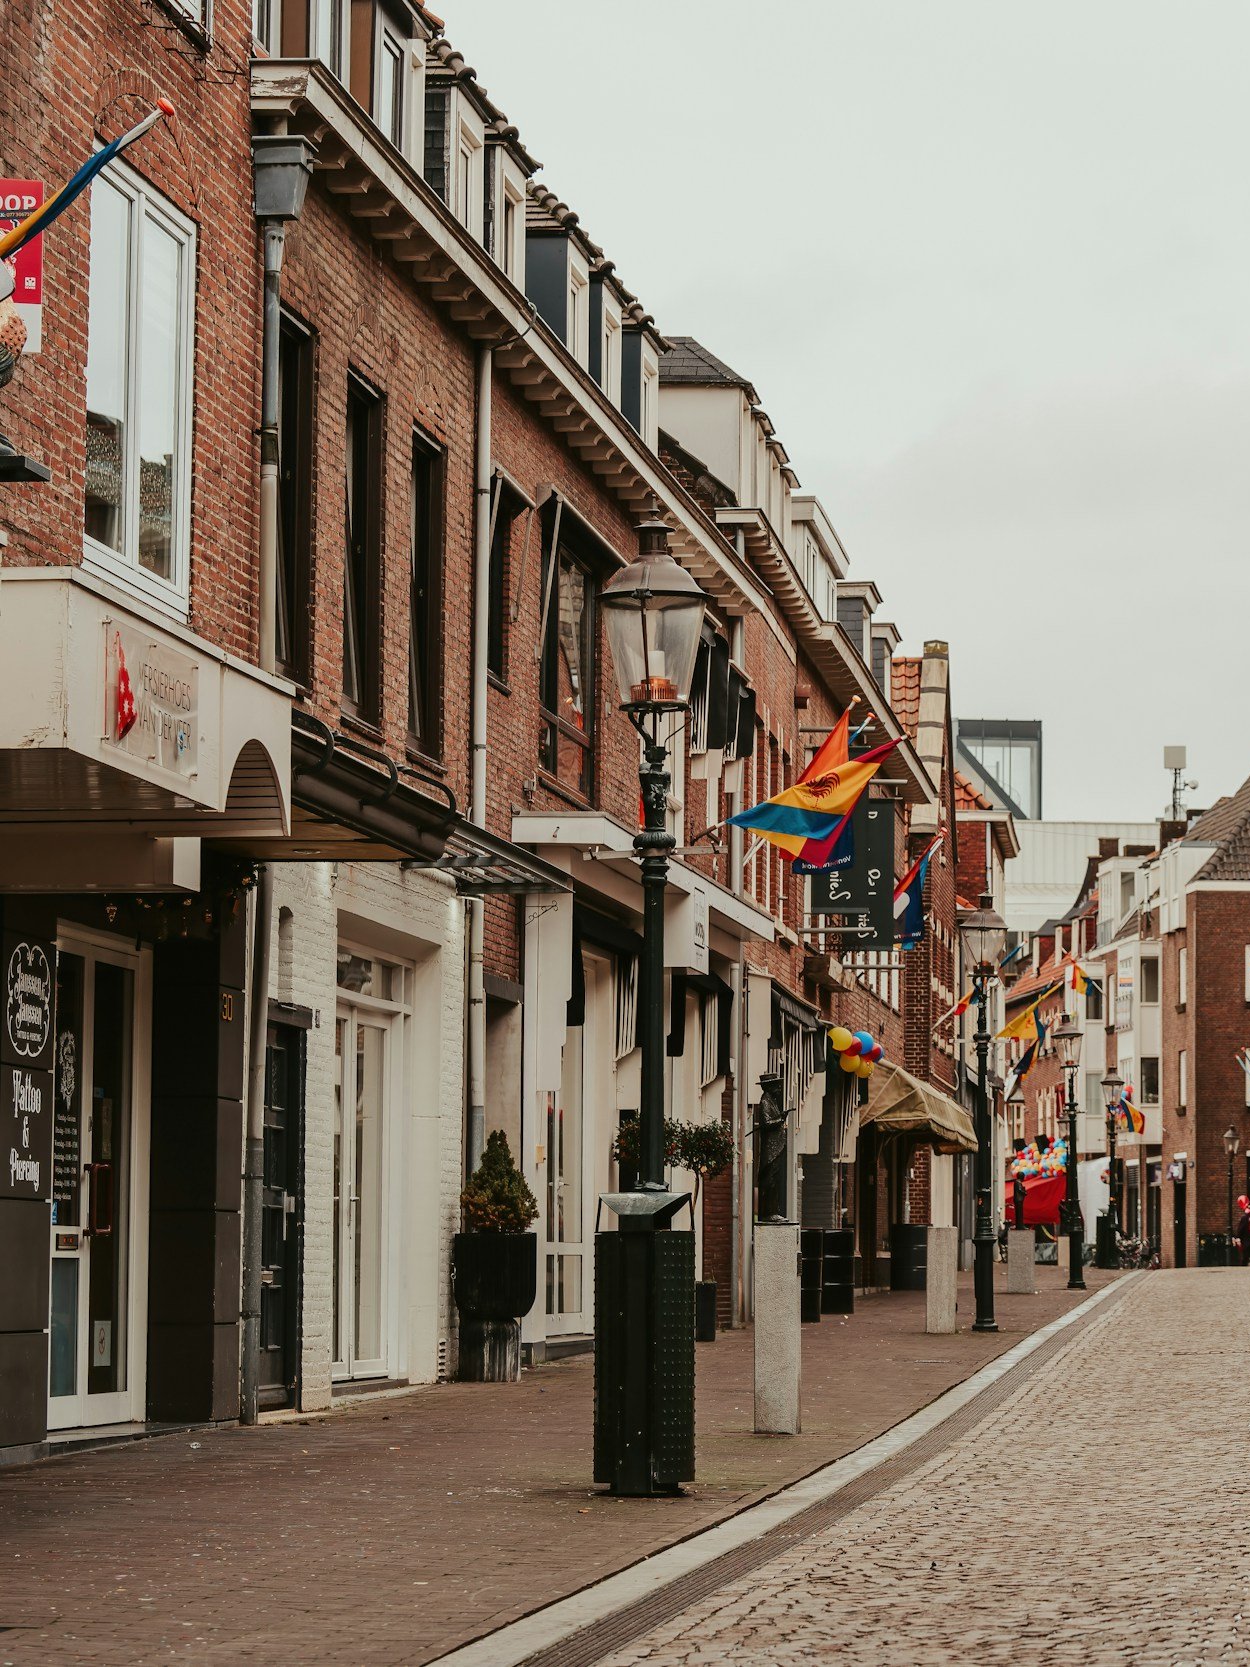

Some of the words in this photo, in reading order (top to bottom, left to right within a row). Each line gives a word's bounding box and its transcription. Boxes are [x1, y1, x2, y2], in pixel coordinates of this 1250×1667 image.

[139, 660, 190, 712] VERSIERHOES
[138, 700, 156, 734] VAN
[158, 710, 173, 742] DER
[222, 993, 233, 1021] 30
[12, 1069, 41, 1118] Tattoo
[22, 1115, 30, 1149] &
[9, 1147, 40, 1192] Piercing
